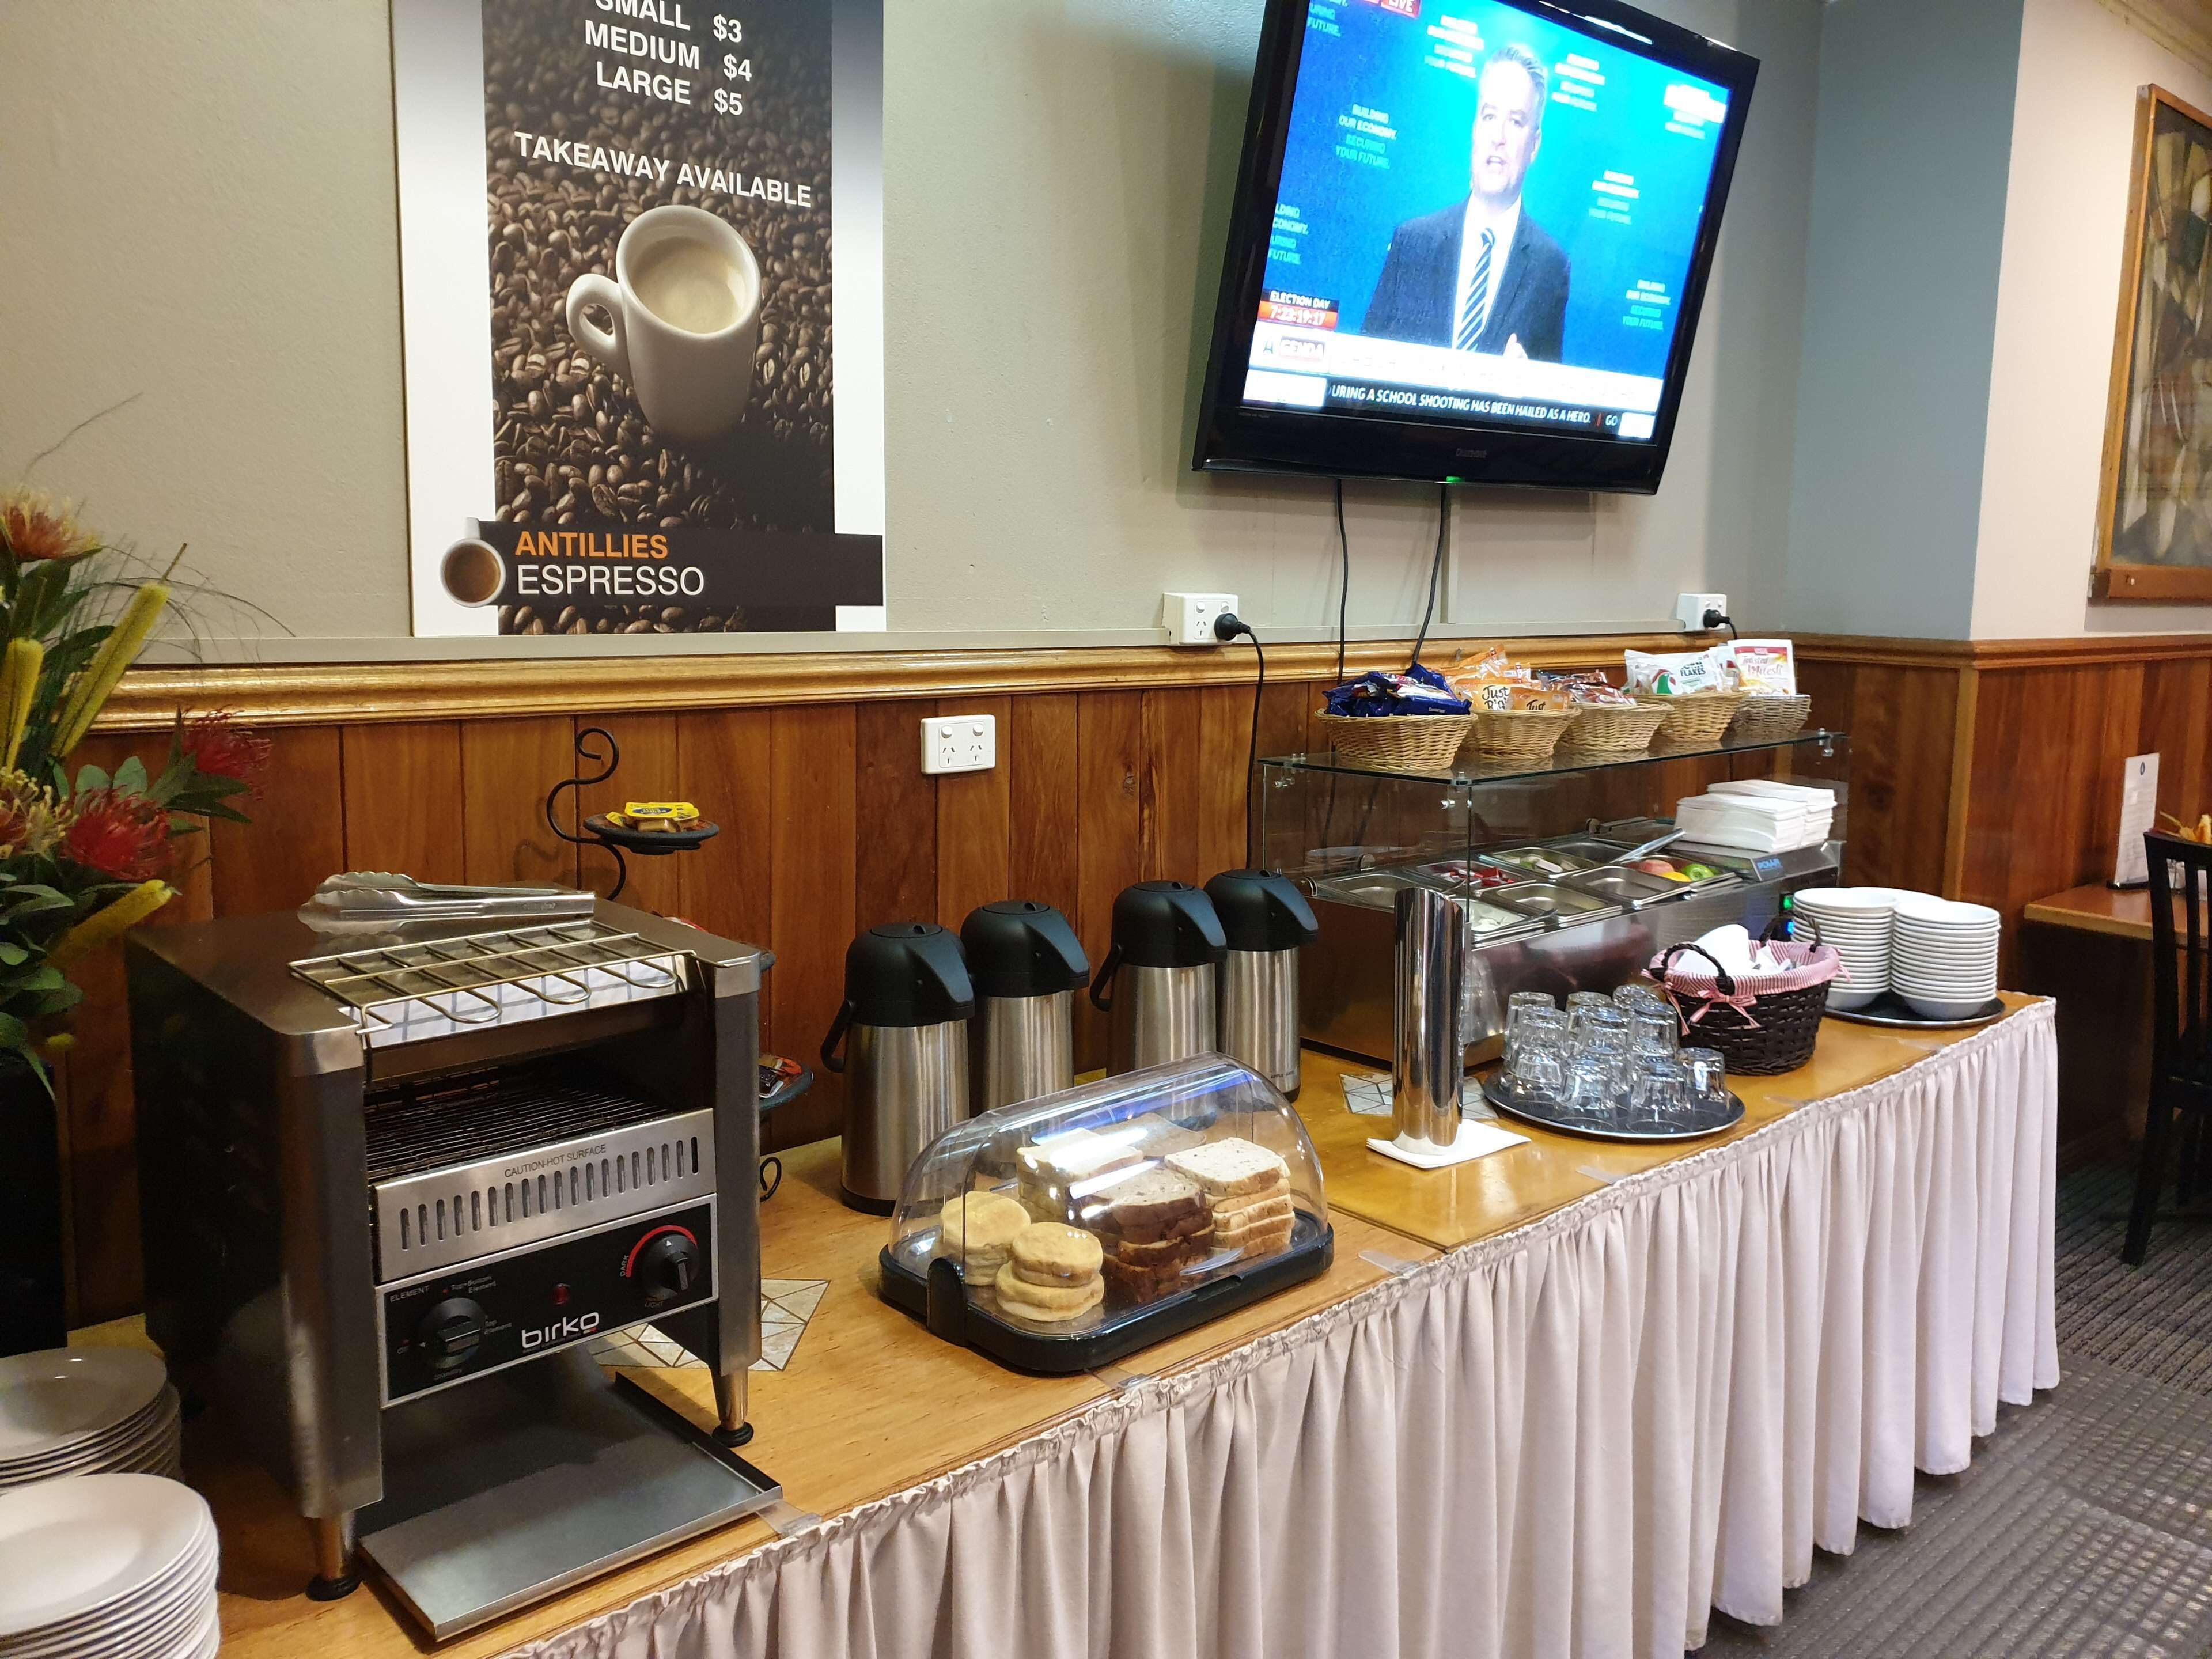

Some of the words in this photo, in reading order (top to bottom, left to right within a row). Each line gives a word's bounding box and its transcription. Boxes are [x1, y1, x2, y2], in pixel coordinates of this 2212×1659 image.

[713, 14, 742, 43] $3
[585, 19, 699, 70] MEDIUM
[724, 53, 752, 82] $4
[597, 60, 691, 105] LARGE
[714, 87, 743, 115] $5
[514, 131, 669, 181] TAKEAWAY
[677, 162, 811, 208] AVAILABLE
[1270, 290, 1312, 306] ELECTION
[1313, 297, 1330, 309] DAY
[1366, 388, 1376, 401] A
[1377, 389, 1417, 405] SCHOOL
[1419, 393, 1470, 411] SHOOTING
[1470, 399, 1491, 412] HAS
[1491, 402, 1515, 415] BEEN
[1515, 404, 1547, 419] HAILED
[1547, 408, 1559, 420] AS
[1559, 409, 1566, 420] A
[515, 531, 669, 559] ANTILLIES
[518, 565, 704, 596] ESPRESSO
[1680, 668, 1706, 676] FLAKES
[1482, 684, 1509, 700] Just
[567, 1144, 606, 1162] SURFACE
[619, 1255, 629, 1277] DARK
[390, 1285, 430, 1302] ELEMENT
[521, 1312, 600, 1349] birko
